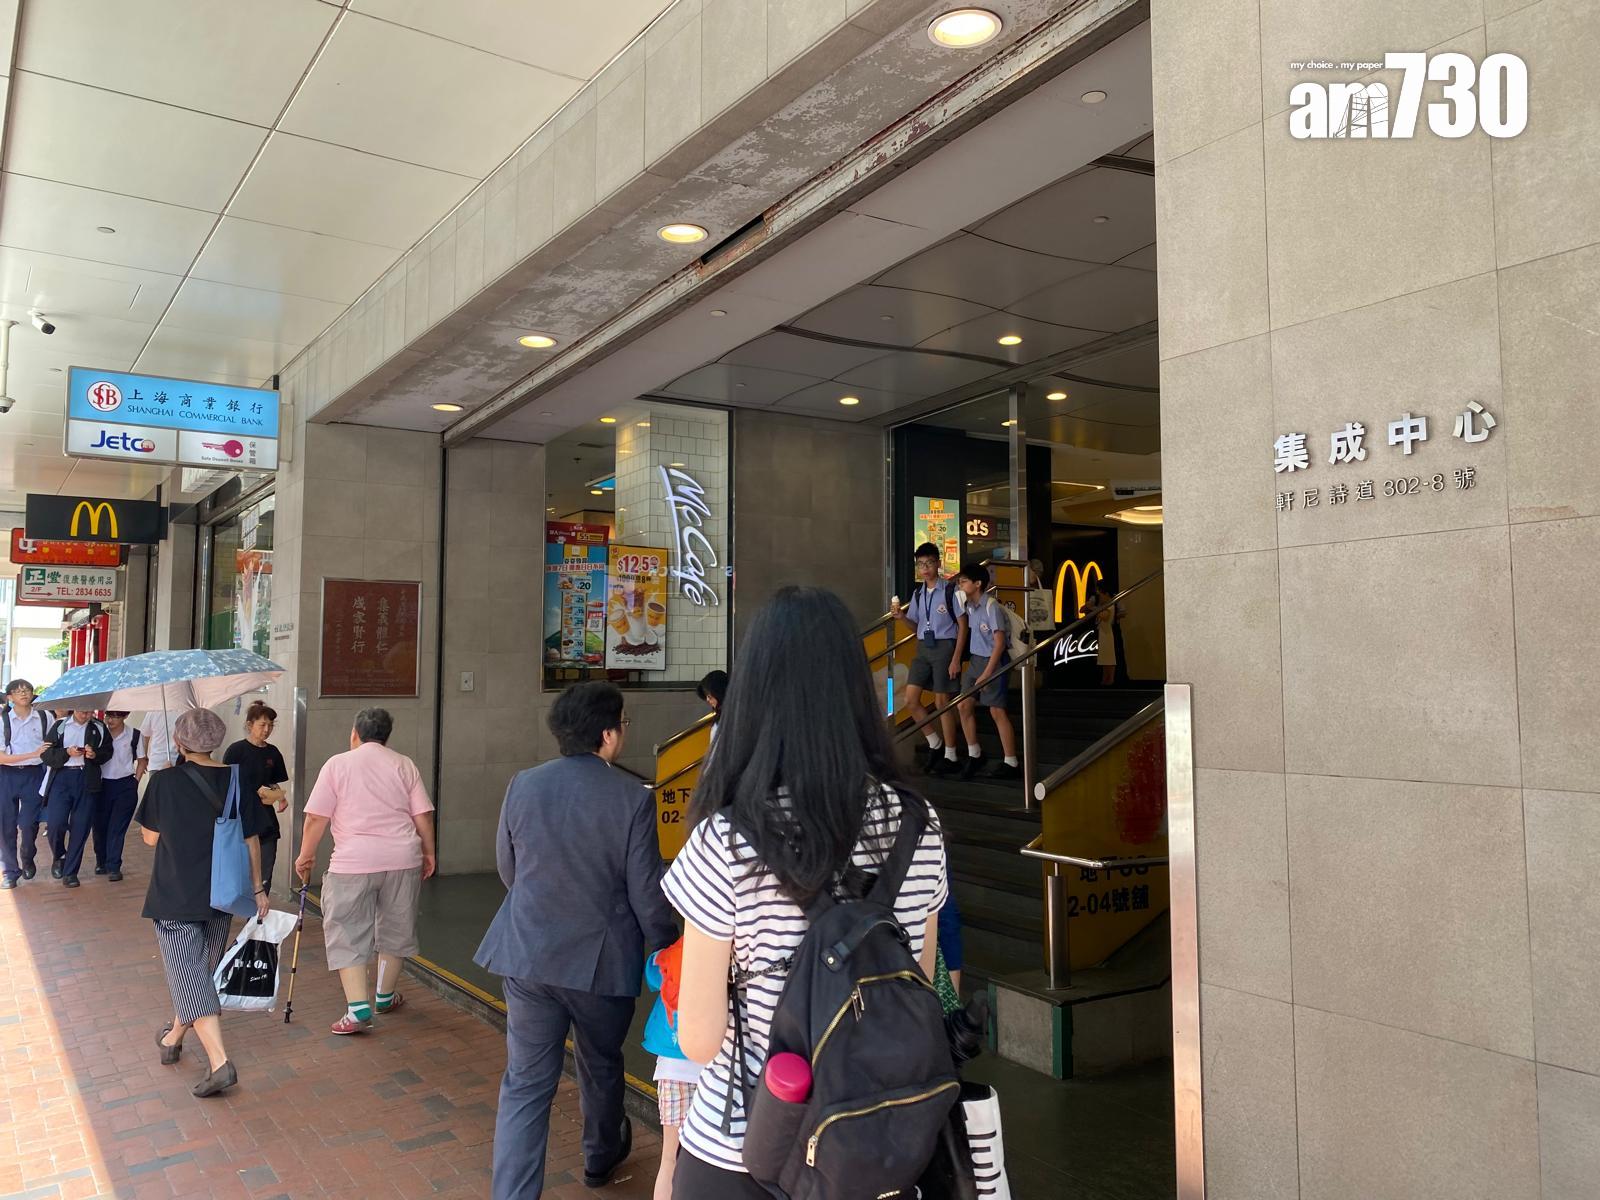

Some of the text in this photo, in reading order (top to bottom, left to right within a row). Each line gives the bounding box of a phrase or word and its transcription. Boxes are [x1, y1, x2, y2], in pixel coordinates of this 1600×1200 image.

[127, 388, 264, 415] 上海商業銀行
[127, 404, 264, 426] SHANGHAI COMMERCIAL BANK
[1273, 399, 1498, 474] 集成中心
[56, 586, 74, 596] TEL:
[75, 587, 93, 597] 2834
[1053, 629, 1099, 666] McCa
[662, 788, 691, 804] 地下
